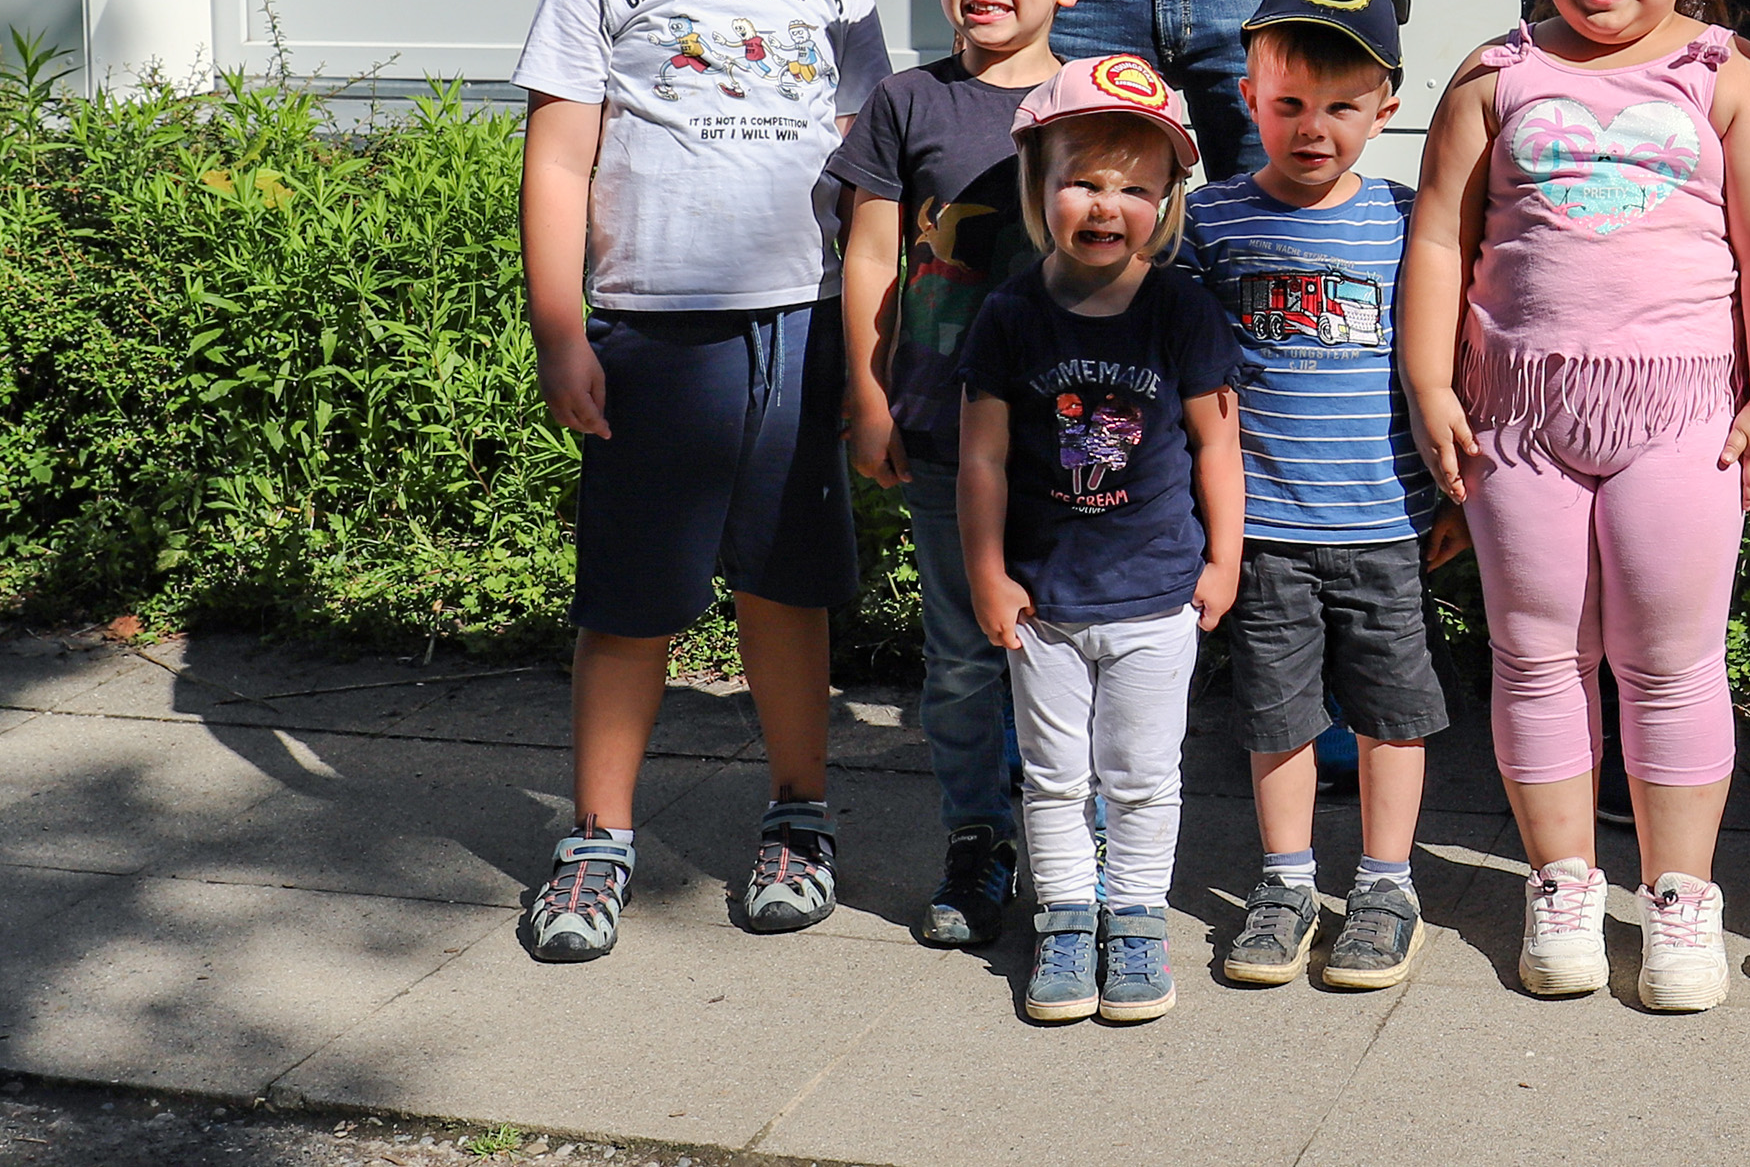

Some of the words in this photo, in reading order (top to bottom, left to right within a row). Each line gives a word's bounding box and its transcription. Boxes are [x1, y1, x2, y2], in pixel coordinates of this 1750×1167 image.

[689, 117, 700, 127] IT
[702, 117, 712, 127] IS
[715, 116, 736, 127] NOT
[740, 117, 747, 126] A
[750, 117, 808, 129] COMPETITION
[701, 128, 725, 140] BUT
[730, 128, 735, 140] I
[741, 128, 770, 140] WILL
[776, 129, 799, 141] WIN
[1583, 186, 1629, 199] PRETTY
[1248, 238, 1273, 250] MEINE
[1275, 242, 1302, 257] WACHE
[1299, 359, 1318, 371] 112
[1076, 489, 1129, 507] CREAM
